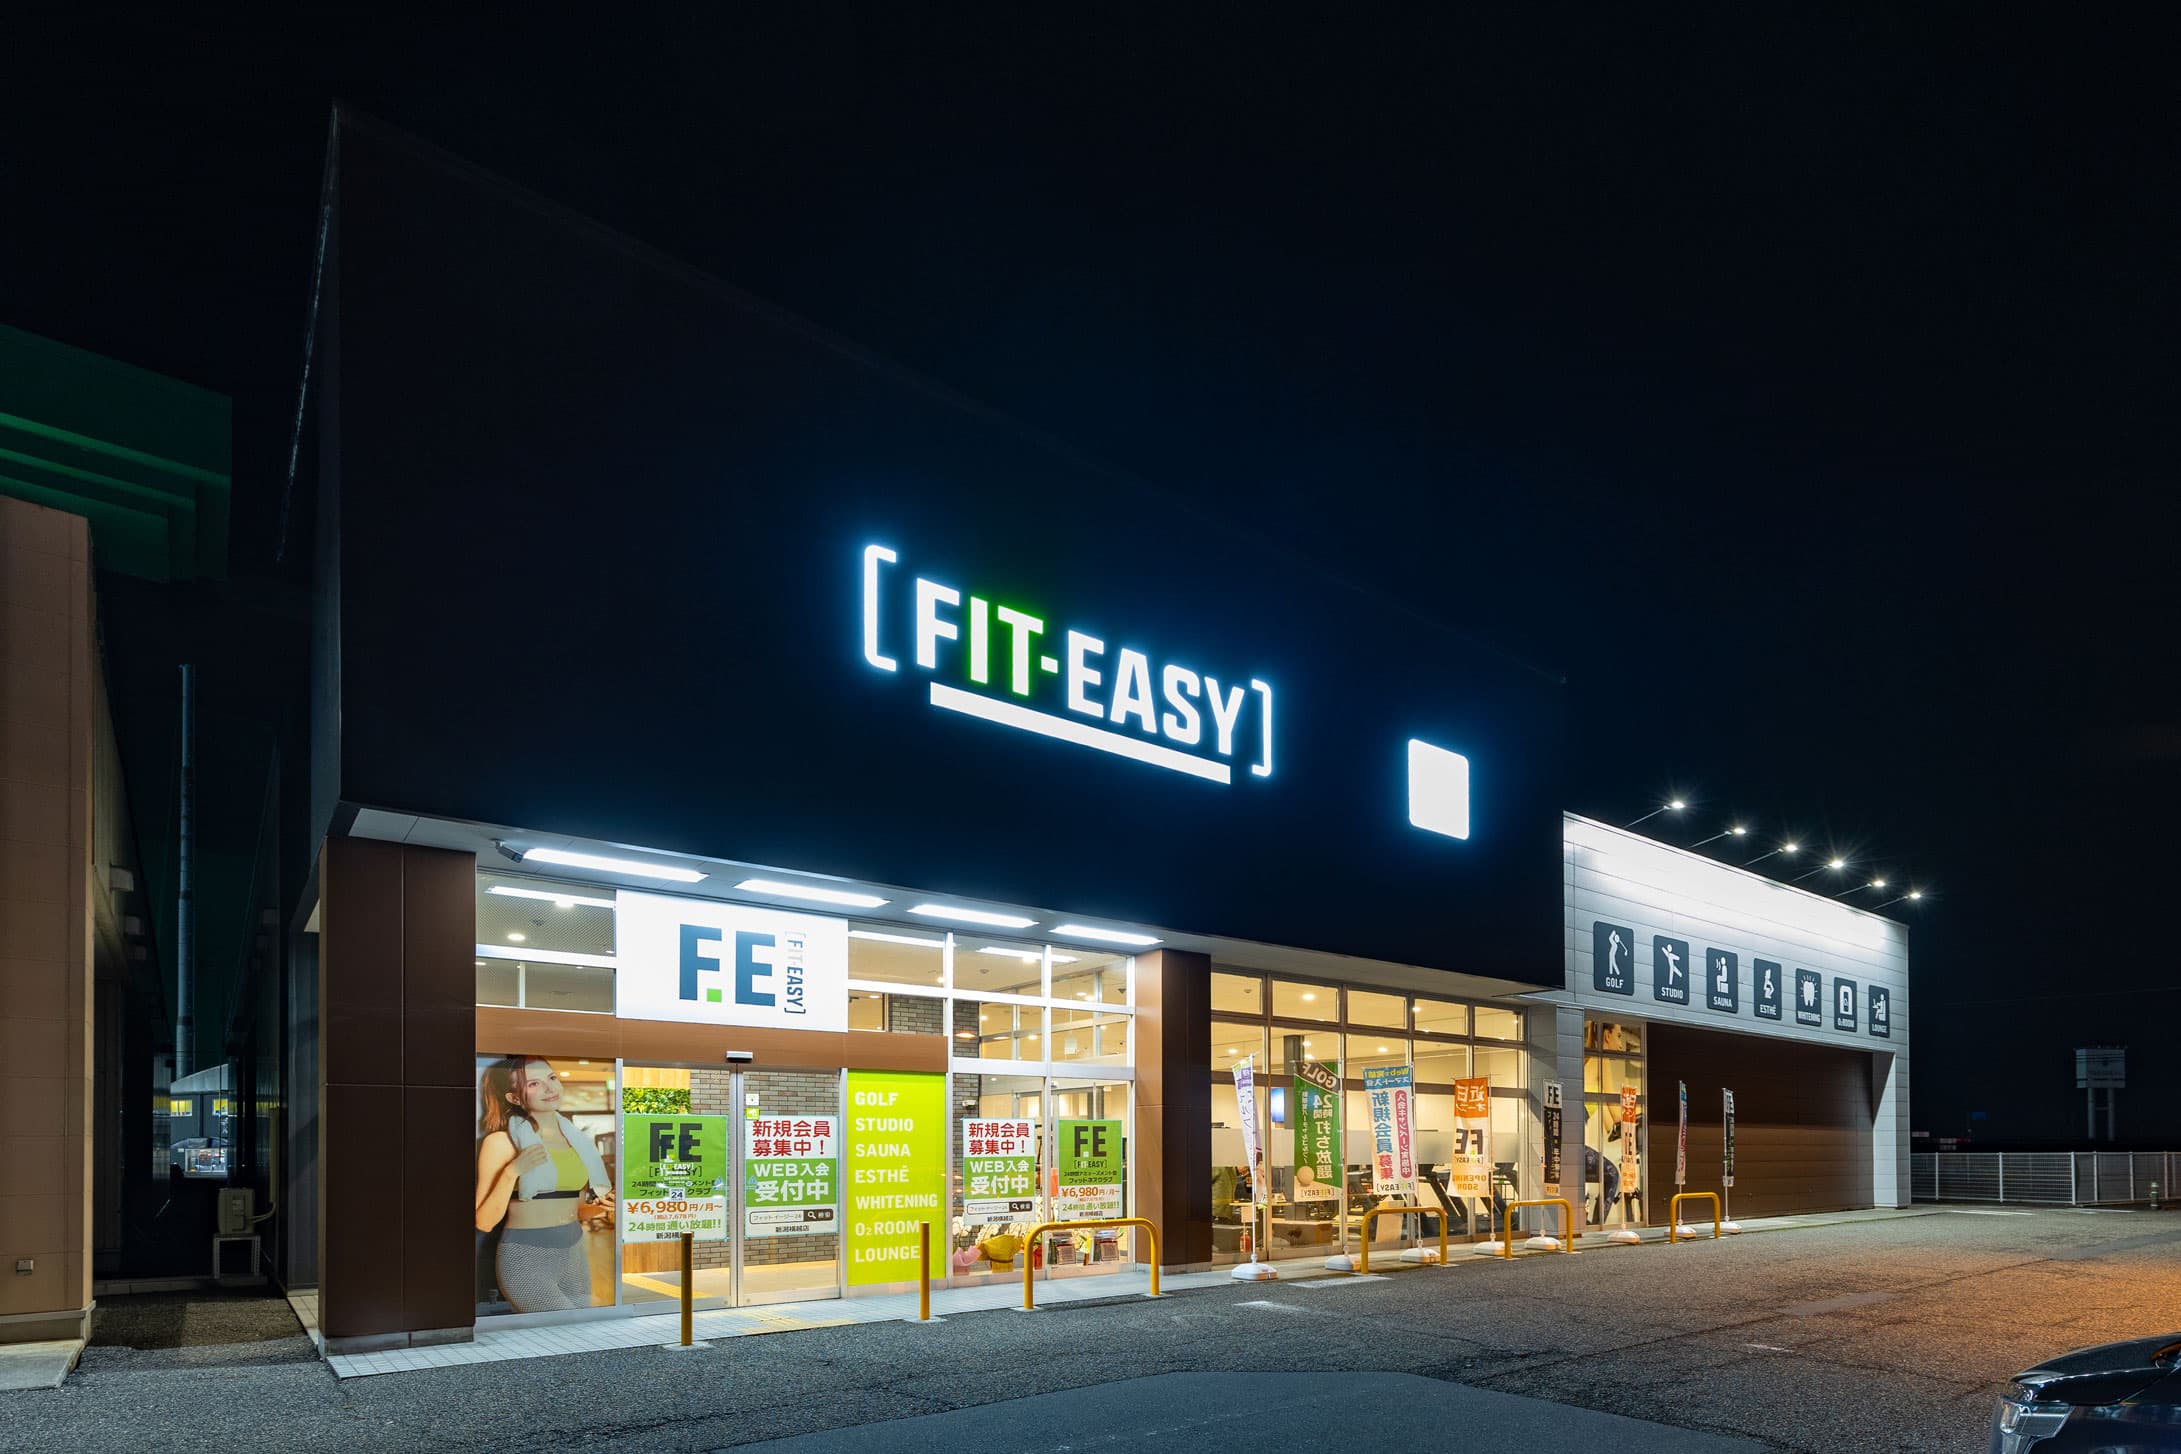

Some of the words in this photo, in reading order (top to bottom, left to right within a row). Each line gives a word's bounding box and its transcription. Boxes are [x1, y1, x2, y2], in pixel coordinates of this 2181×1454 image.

[1605, 977, 1624, 989] GOLF
[1661, 987, 1683, 1000] STUDIO
[1713, 996, 1733, 1008] SAUNA
[855, 1092, 899, 1106] GOLF
[752, 1120, 831, 1138] 新規会員
[855, 1117, 914, 1132] STUDIO
[968, 1122, 1031, 1138] 新規会員
[855, 1143, 911, 1157] SAUNA
[753, 1162, 830, 1178] WEB入会
[970, 1160, 1030, 1174] WEB入会
[754, 1179, 830, 1203] 受付中
[970, 1175, 1030, 1196] 受付中
[855, 1193, 938, 1210] WHITENING
[855, 1245, 921, 1263] LOUNGE
